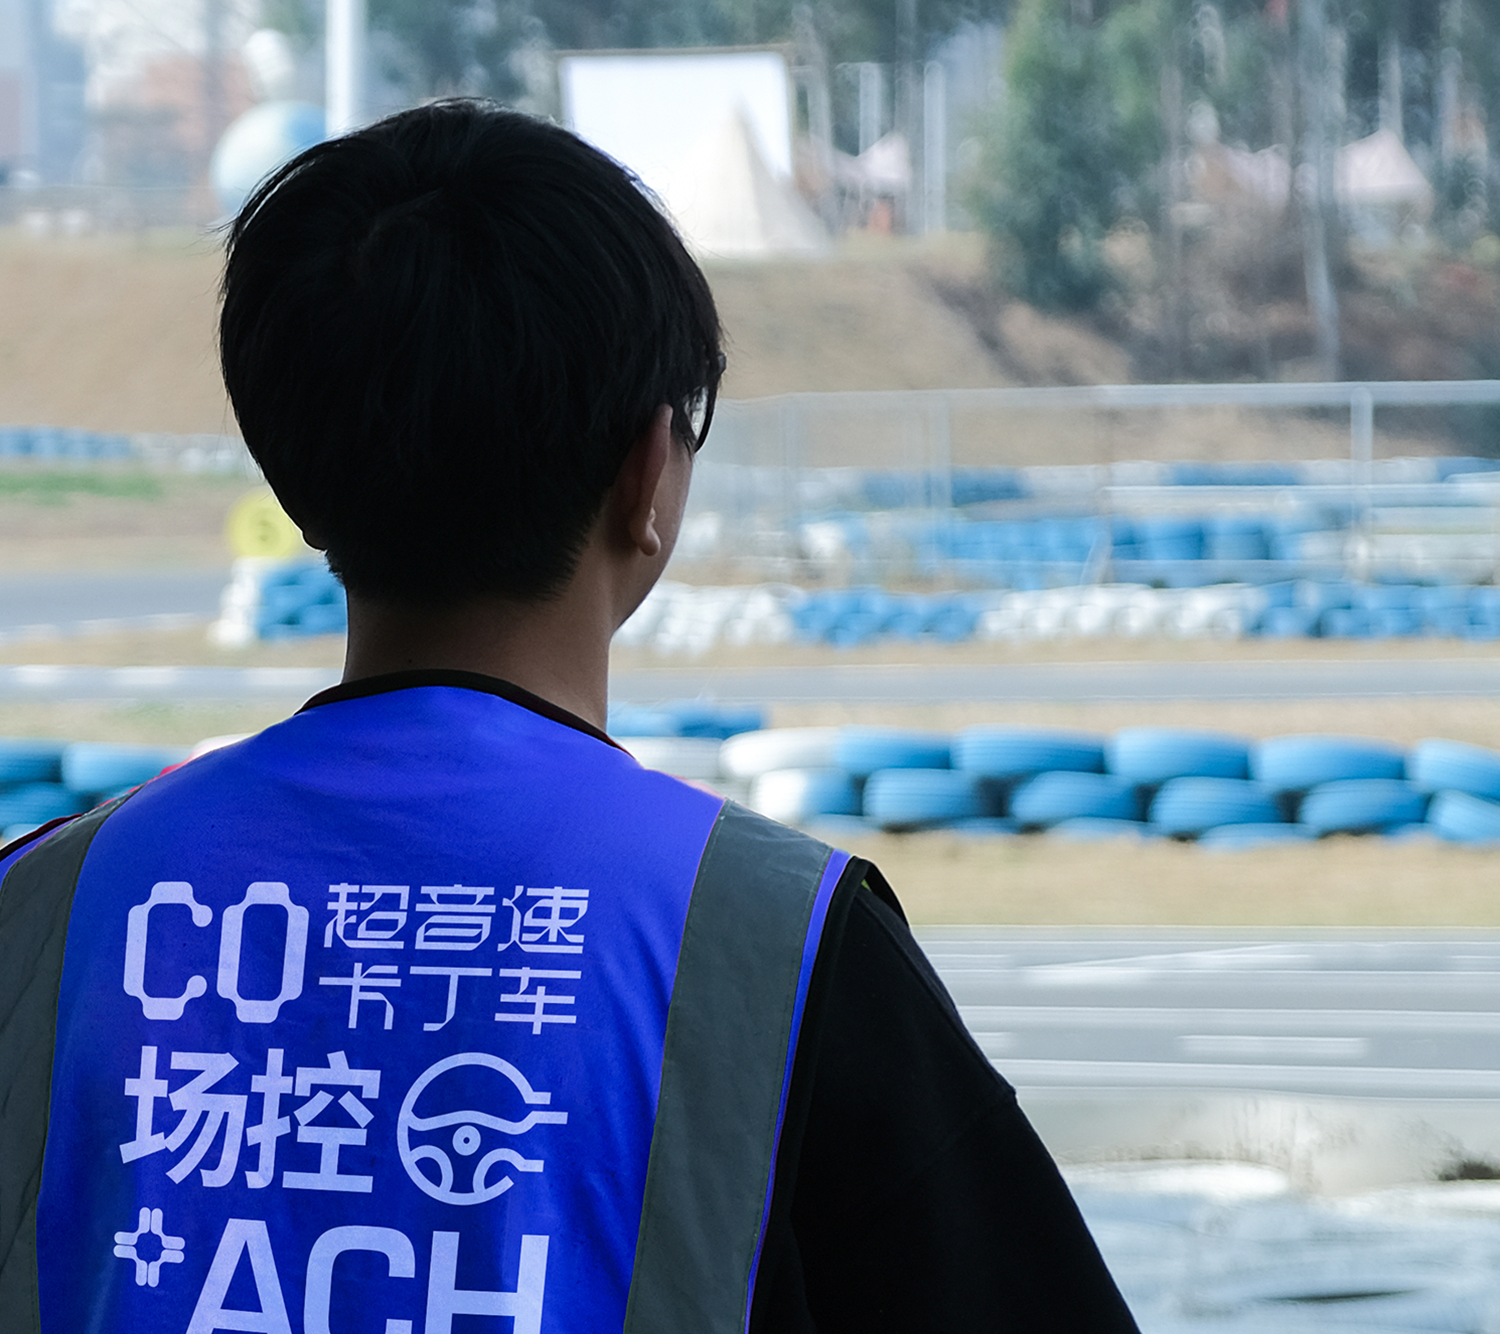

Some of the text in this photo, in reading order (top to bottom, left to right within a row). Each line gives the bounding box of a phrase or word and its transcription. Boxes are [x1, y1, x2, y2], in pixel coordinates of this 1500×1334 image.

[123, 880, 310, 1025] CO
[323, 882, 591, 955] 超音速
[318, 962, 583, 1036] 卡丁车
[119, 1045, 382, 1194] 场控
